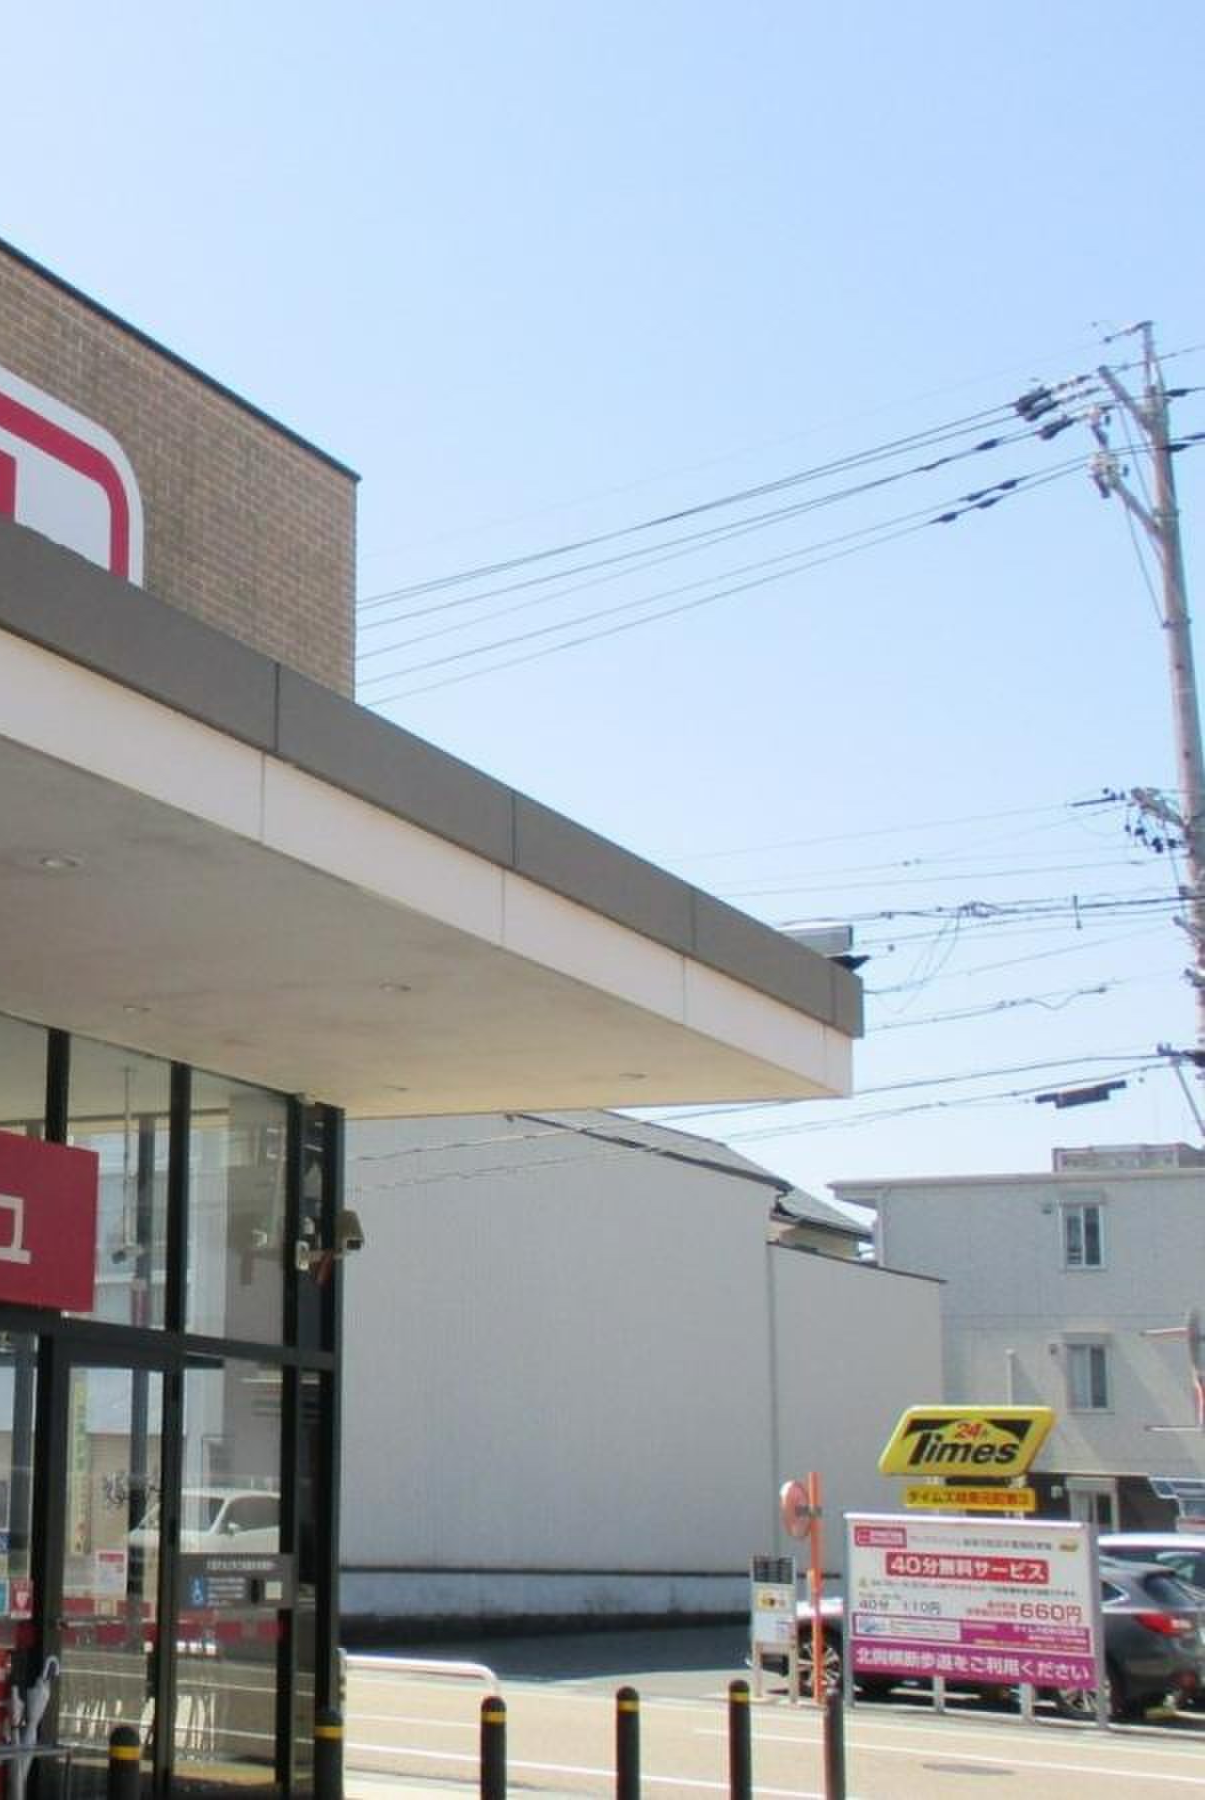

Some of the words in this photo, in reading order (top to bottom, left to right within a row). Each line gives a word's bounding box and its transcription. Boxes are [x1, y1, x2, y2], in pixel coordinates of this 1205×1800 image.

[905, 1429, 1023, 1466] Times
[890, 1555, 1046, 1581] 40分無料サービス
